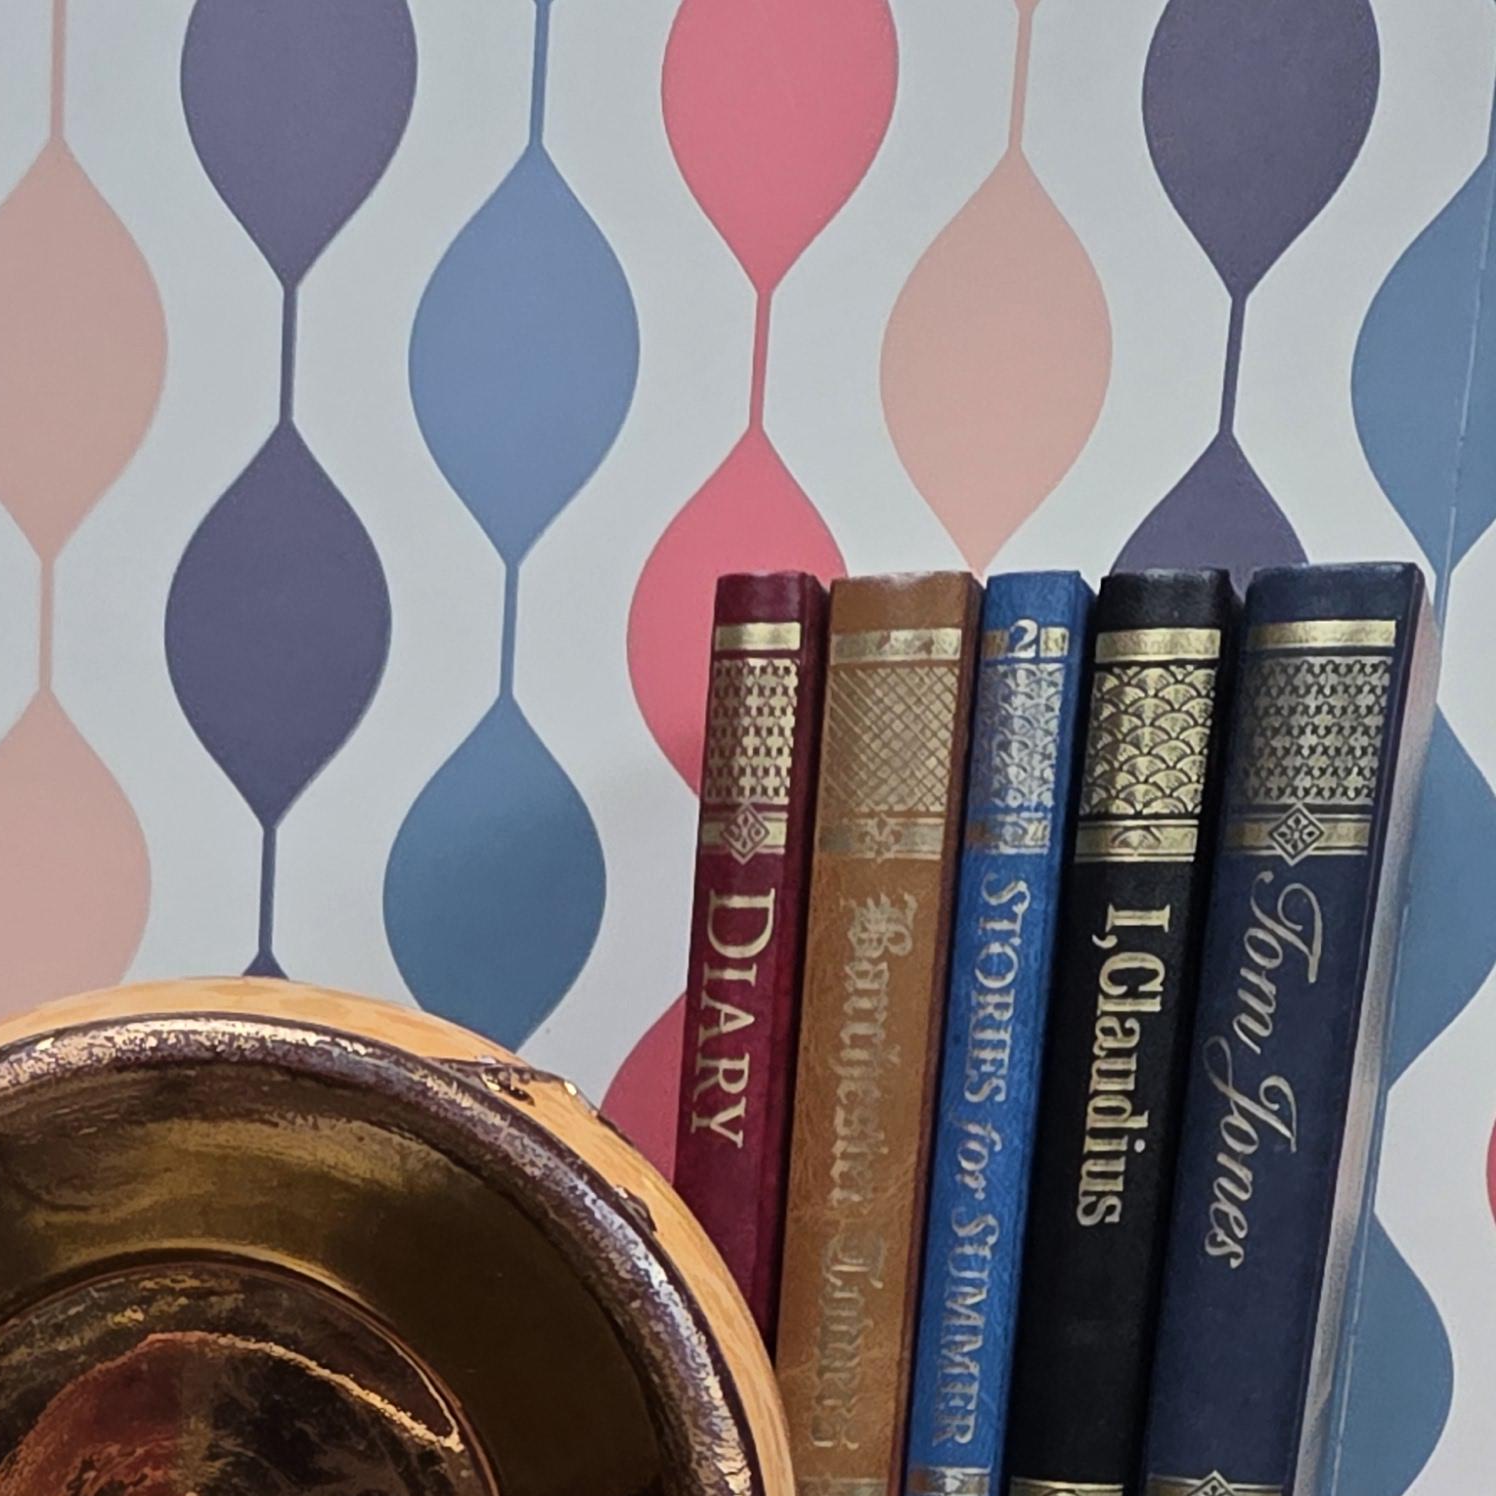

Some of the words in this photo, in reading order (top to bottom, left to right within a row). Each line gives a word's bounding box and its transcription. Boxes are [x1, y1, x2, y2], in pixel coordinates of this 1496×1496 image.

[1008, 618, 1038, 659] 2
[691, 887, 775, 1149] DIARY
[828, 892, 918, 1208] Barchester
[964, 874, 1031, 1103] STORIES
[1233, 871, 1323, 1054] Tom
[952, 1114, 1002, 1200] for
[1205, 1036, 1297, 1269] Jones
[933, 1205, 1000, 1447] SUMMER
